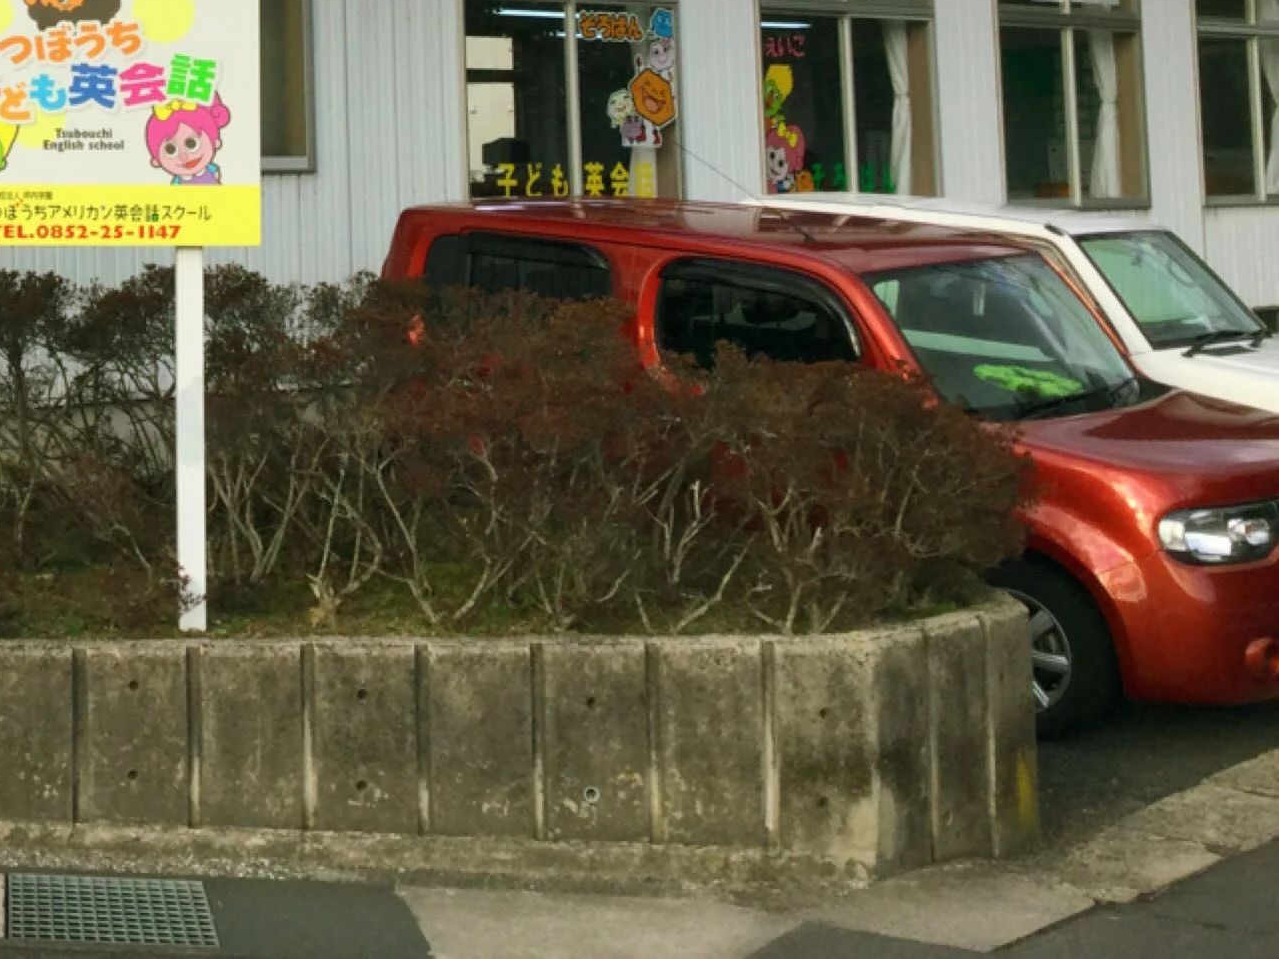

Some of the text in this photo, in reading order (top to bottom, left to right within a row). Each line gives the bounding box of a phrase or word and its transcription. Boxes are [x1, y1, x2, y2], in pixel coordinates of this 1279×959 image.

[55, 127, 113, 139] Tsubouchi
[42, 140, 125, 152] English school
